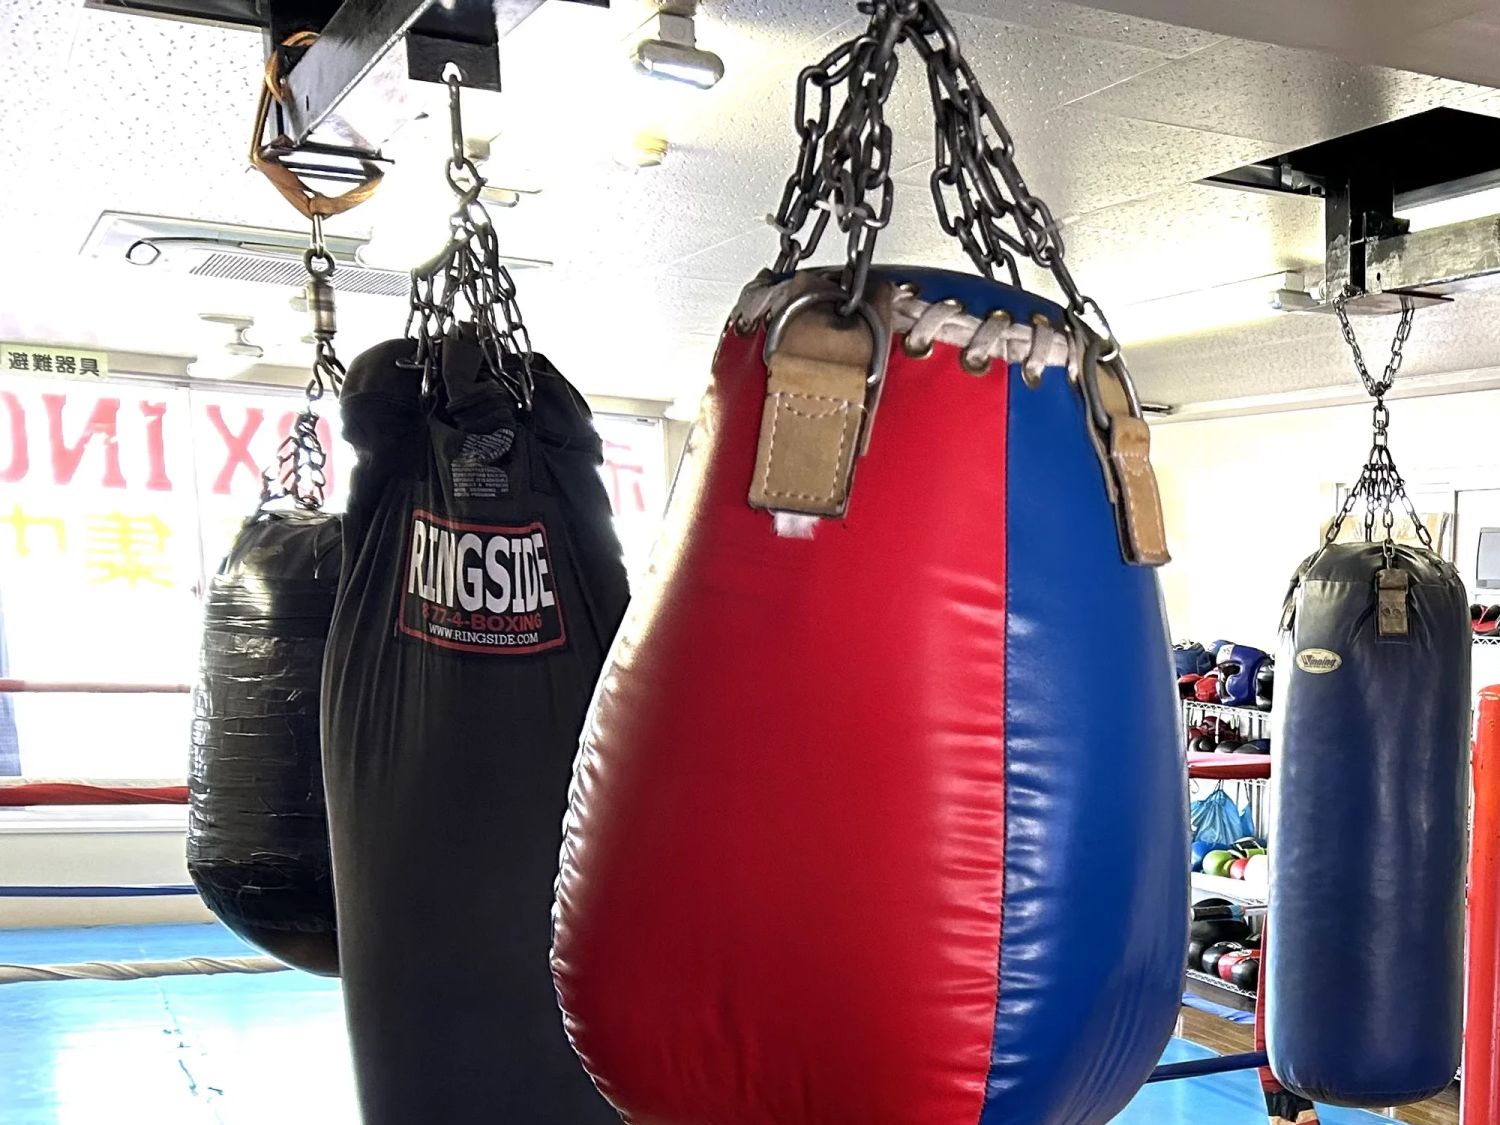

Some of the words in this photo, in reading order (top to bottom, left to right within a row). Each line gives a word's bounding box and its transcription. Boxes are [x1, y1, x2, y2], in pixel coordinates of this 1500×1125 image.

[8, 351, 99, 377] 避難器具
[408, 519, 555, 613] RINGSIDE
[422, 602, 542, 632] 877-4-BOXING
[429, 624, 539, 645] WWW.RINGSIDE.COM
